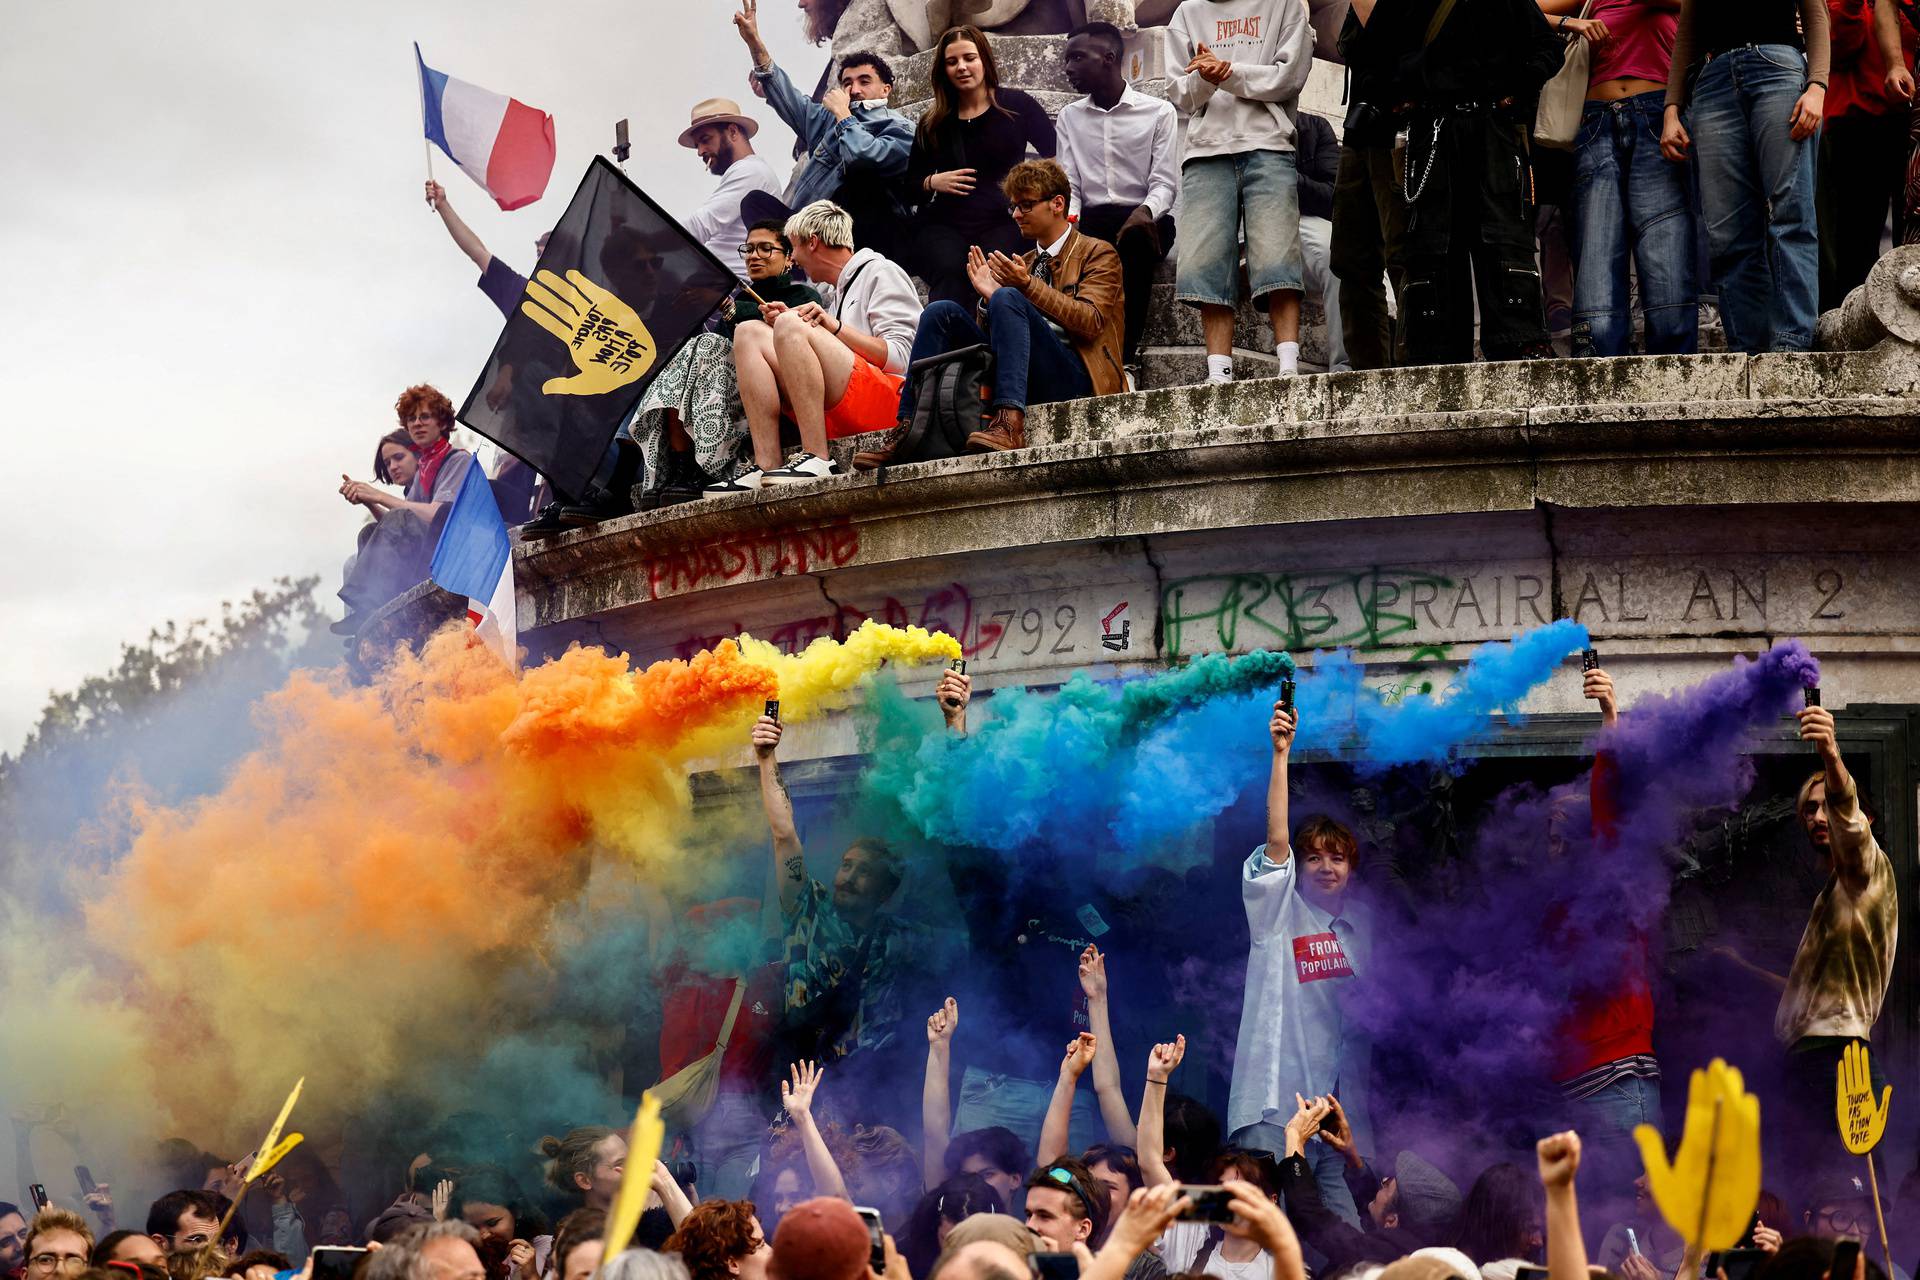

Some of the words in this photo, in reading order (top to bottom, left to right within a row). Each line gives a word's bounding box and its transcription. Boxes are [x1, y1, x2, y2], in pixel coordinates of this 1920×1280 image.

[1215, 16, 1261, 41] EVERLAST
[973, 603, 1076, 661] 1792
[1373, 571, 1648, 632] PRAIRAL
[1681, 569, 1767, 620] AN
[1810, 569, 1845, 619] 2
[1301, 957, 1351, 975] POPULAIR
[1847, 1091, 1870, 1106] TOUCHE
[1849, 1105, 1861, 1119] PAS
[1850, 1130, 1870, 1145] POTE
